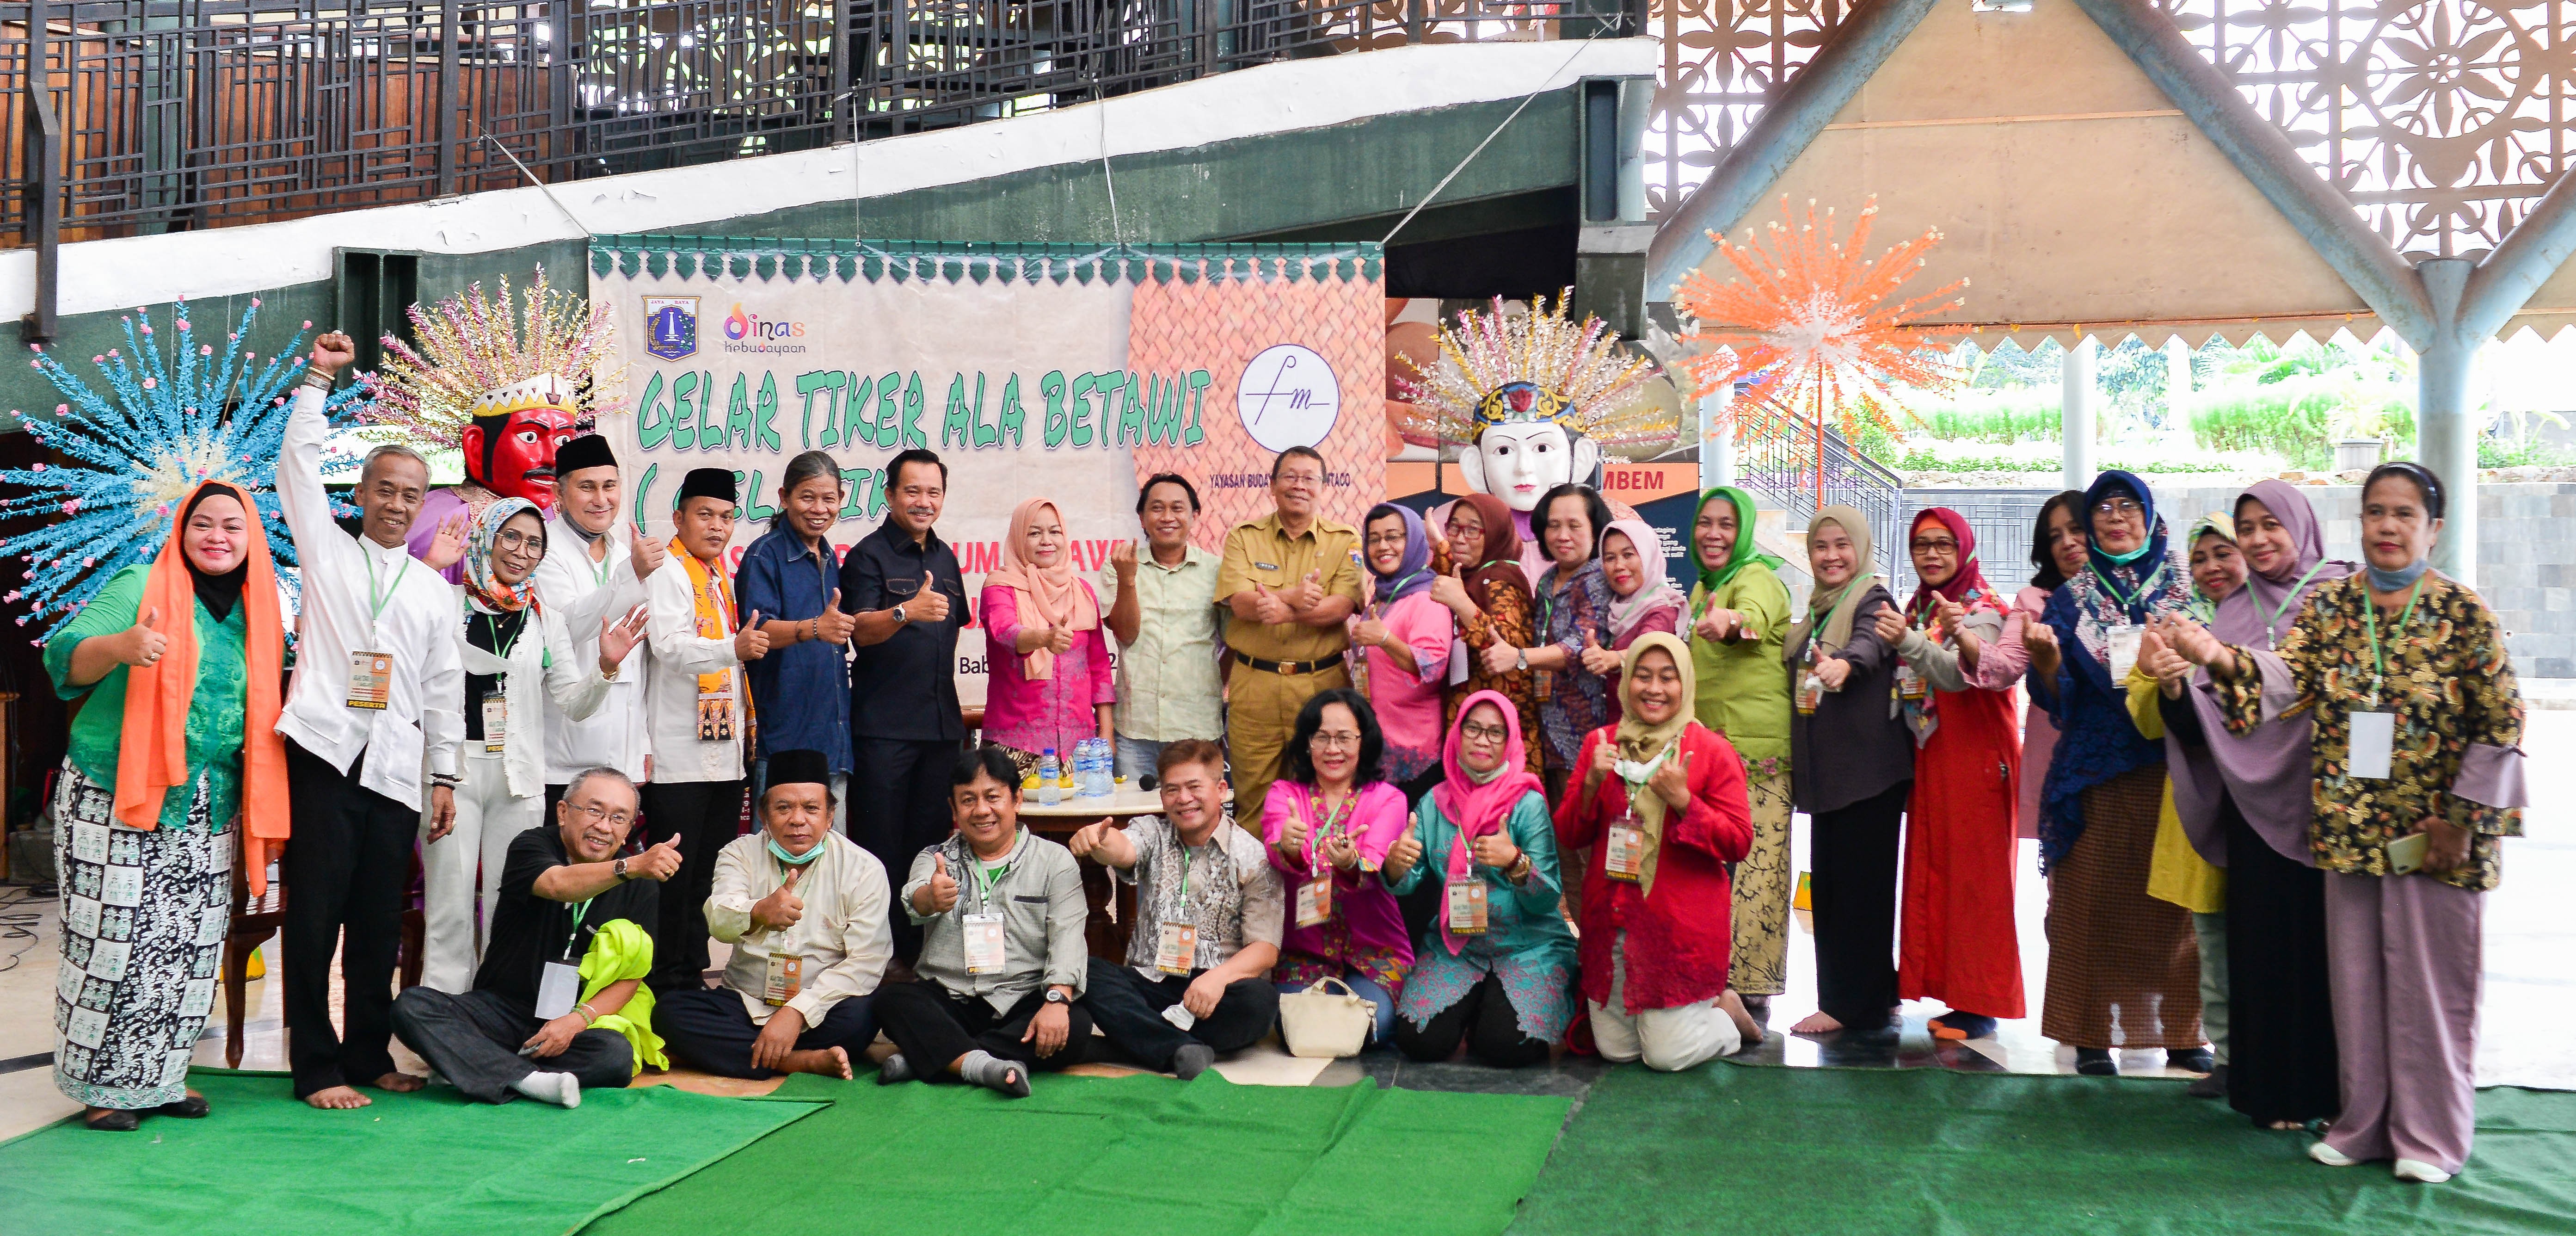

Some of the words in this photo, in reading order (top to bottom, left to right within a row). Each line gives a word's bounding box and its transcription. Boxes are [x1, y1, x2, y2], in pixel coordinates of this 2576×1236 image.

[638, 371, 781, 451] GELAR
[796, 370, 927, 451] TIKER
[942, 371, 1026, 448] ALA
[1040, 369, 1211, 448] BETAWI
[1210, 474, 1245, 488] YAYASAN
[1248, 474, 1272, 488] BUDA
[1603, 471, 1664, 490] MBEM
[349, 700, 386, 709] PESERTA
